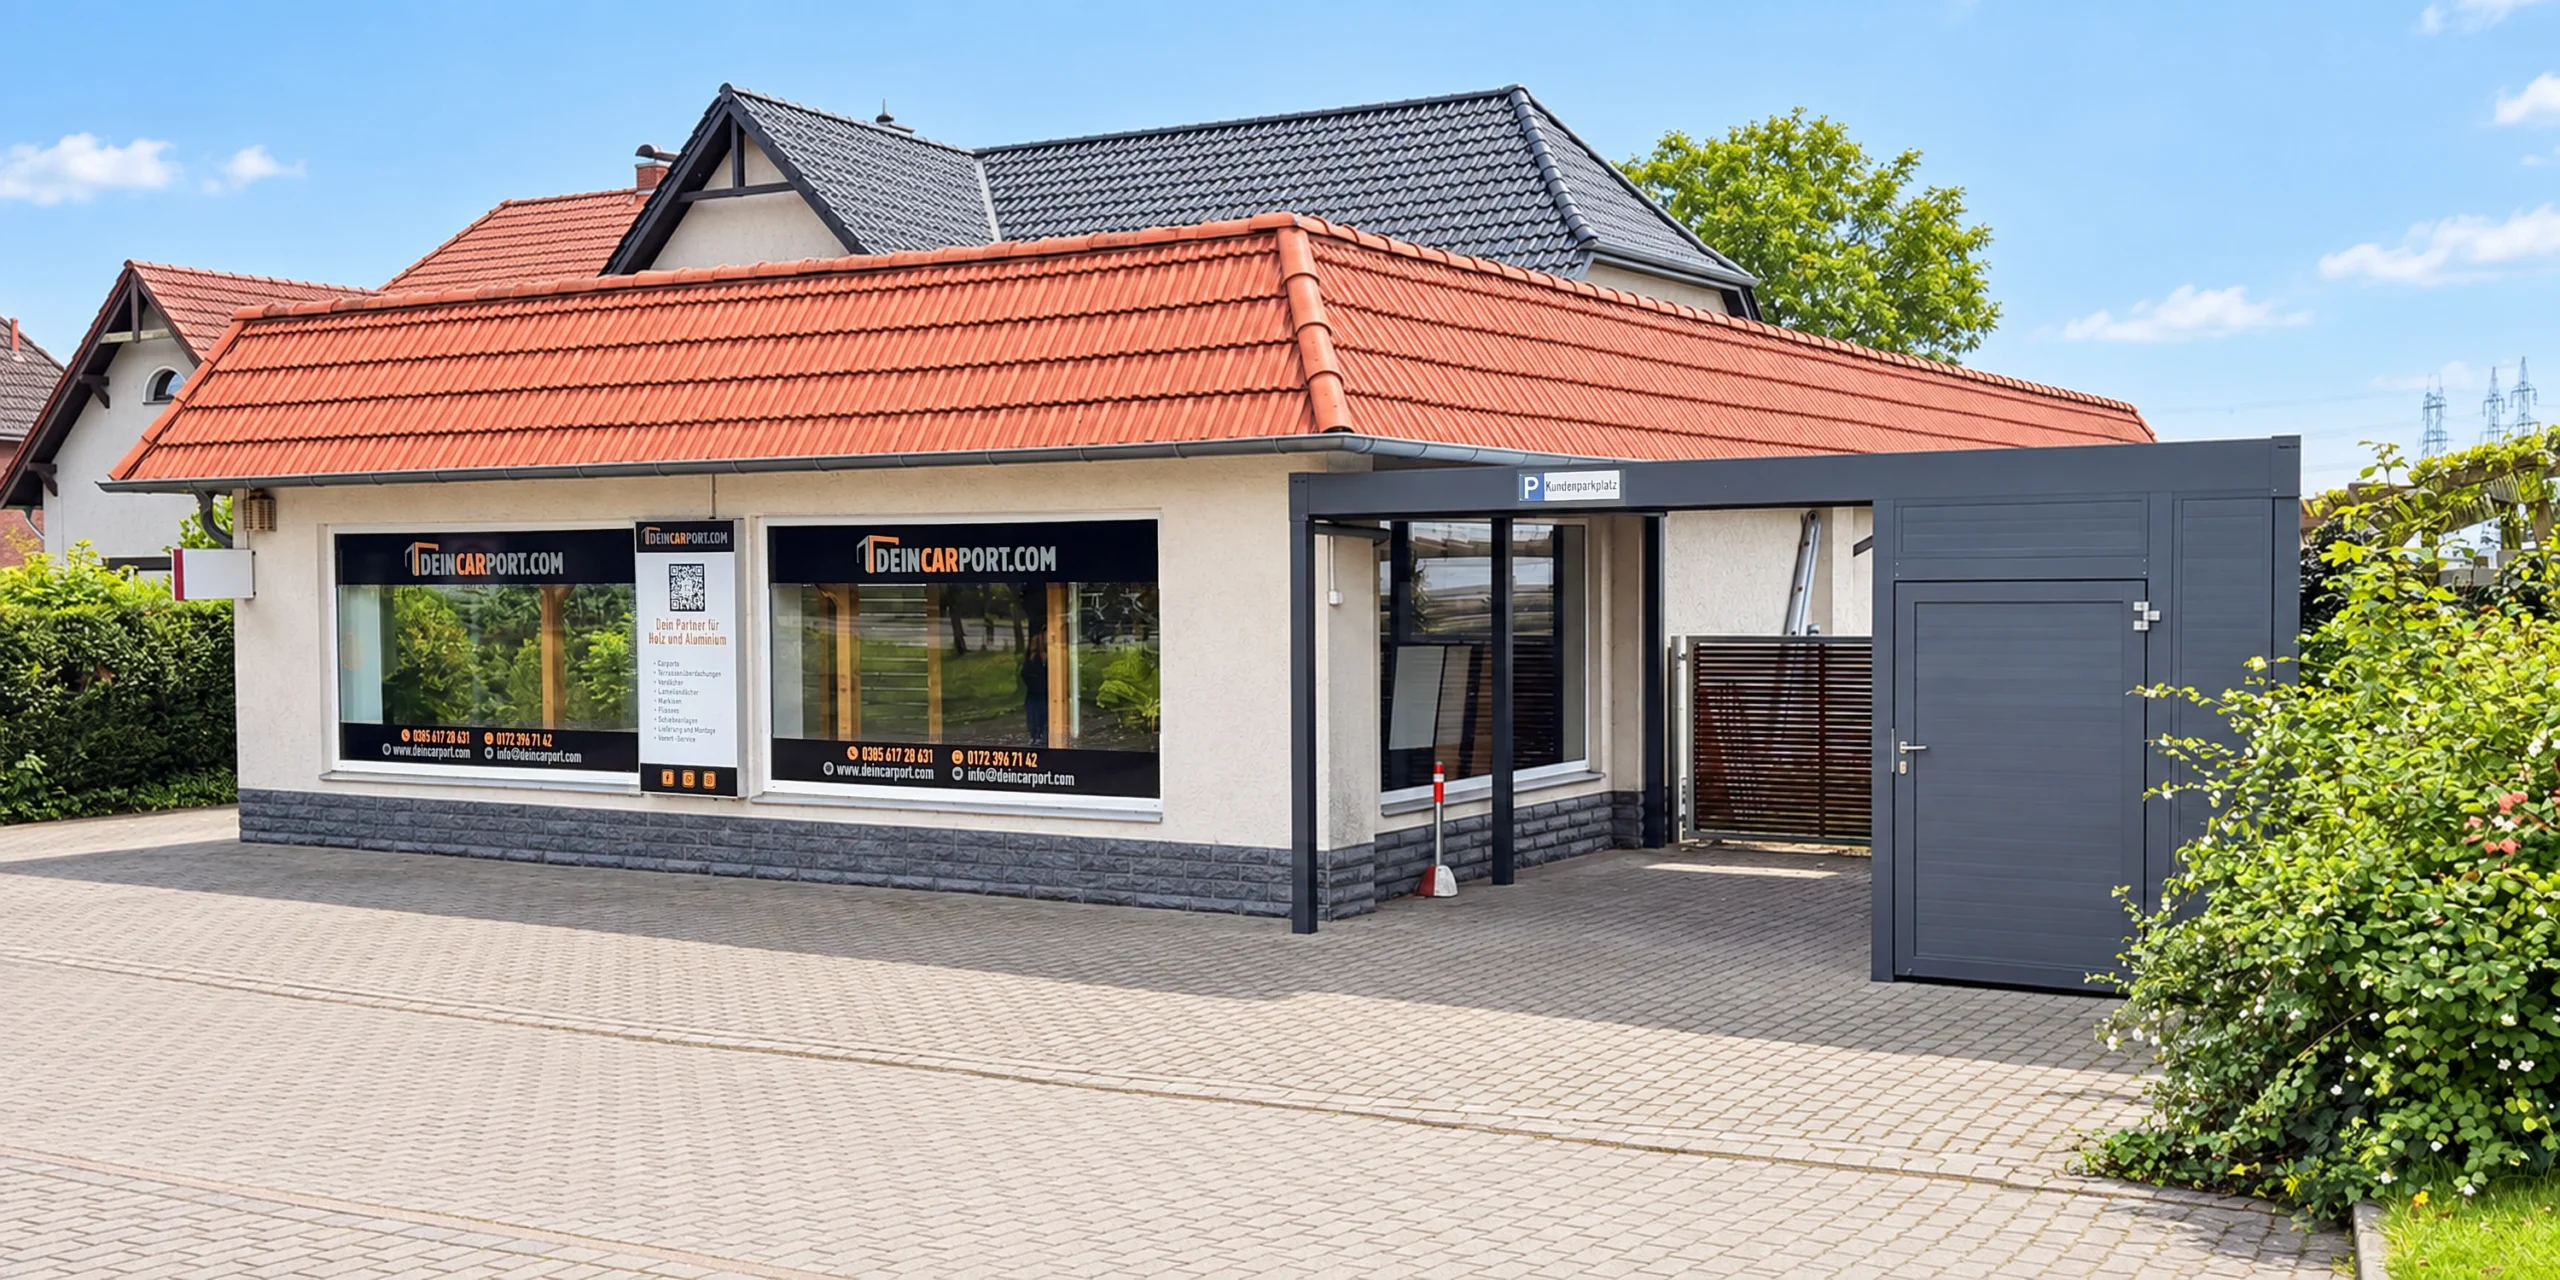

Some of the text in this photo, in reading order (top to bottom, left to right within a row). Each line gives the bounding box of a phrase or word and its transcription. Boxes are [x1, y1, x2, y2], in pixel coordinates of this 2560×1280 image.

[1545, 479, 1618, 493] Kundenparkplatz
[650, 531, 728, 545] DEINCARPORT.COM
[420, 552, 564, 576] DEINCARPORT.COM
[876, 546, 1056, 573] DEINCARPORT.COM
[656, 618, 720, 631] Dein Partner für
[648, 632, 727, 646] Holz und Aluminium
[657, 660, 680, 668] Carports
[413, 729, 470, 744] 0385 617 28 631
[496, 732, 553, 747] 0172 396 71 42
[392, 744, 471, 760] www.deincarport.com
[496, 747, 582, 764] info@deincarport.com
[862, 746, 933, 763] 0385 617 28 631
[967, 750, 1038, 768] 0172 396 71 42
[836, 762, 934, 781] www.deincarport.com
[967, 766, 1075, 788] info@deincarport.com
